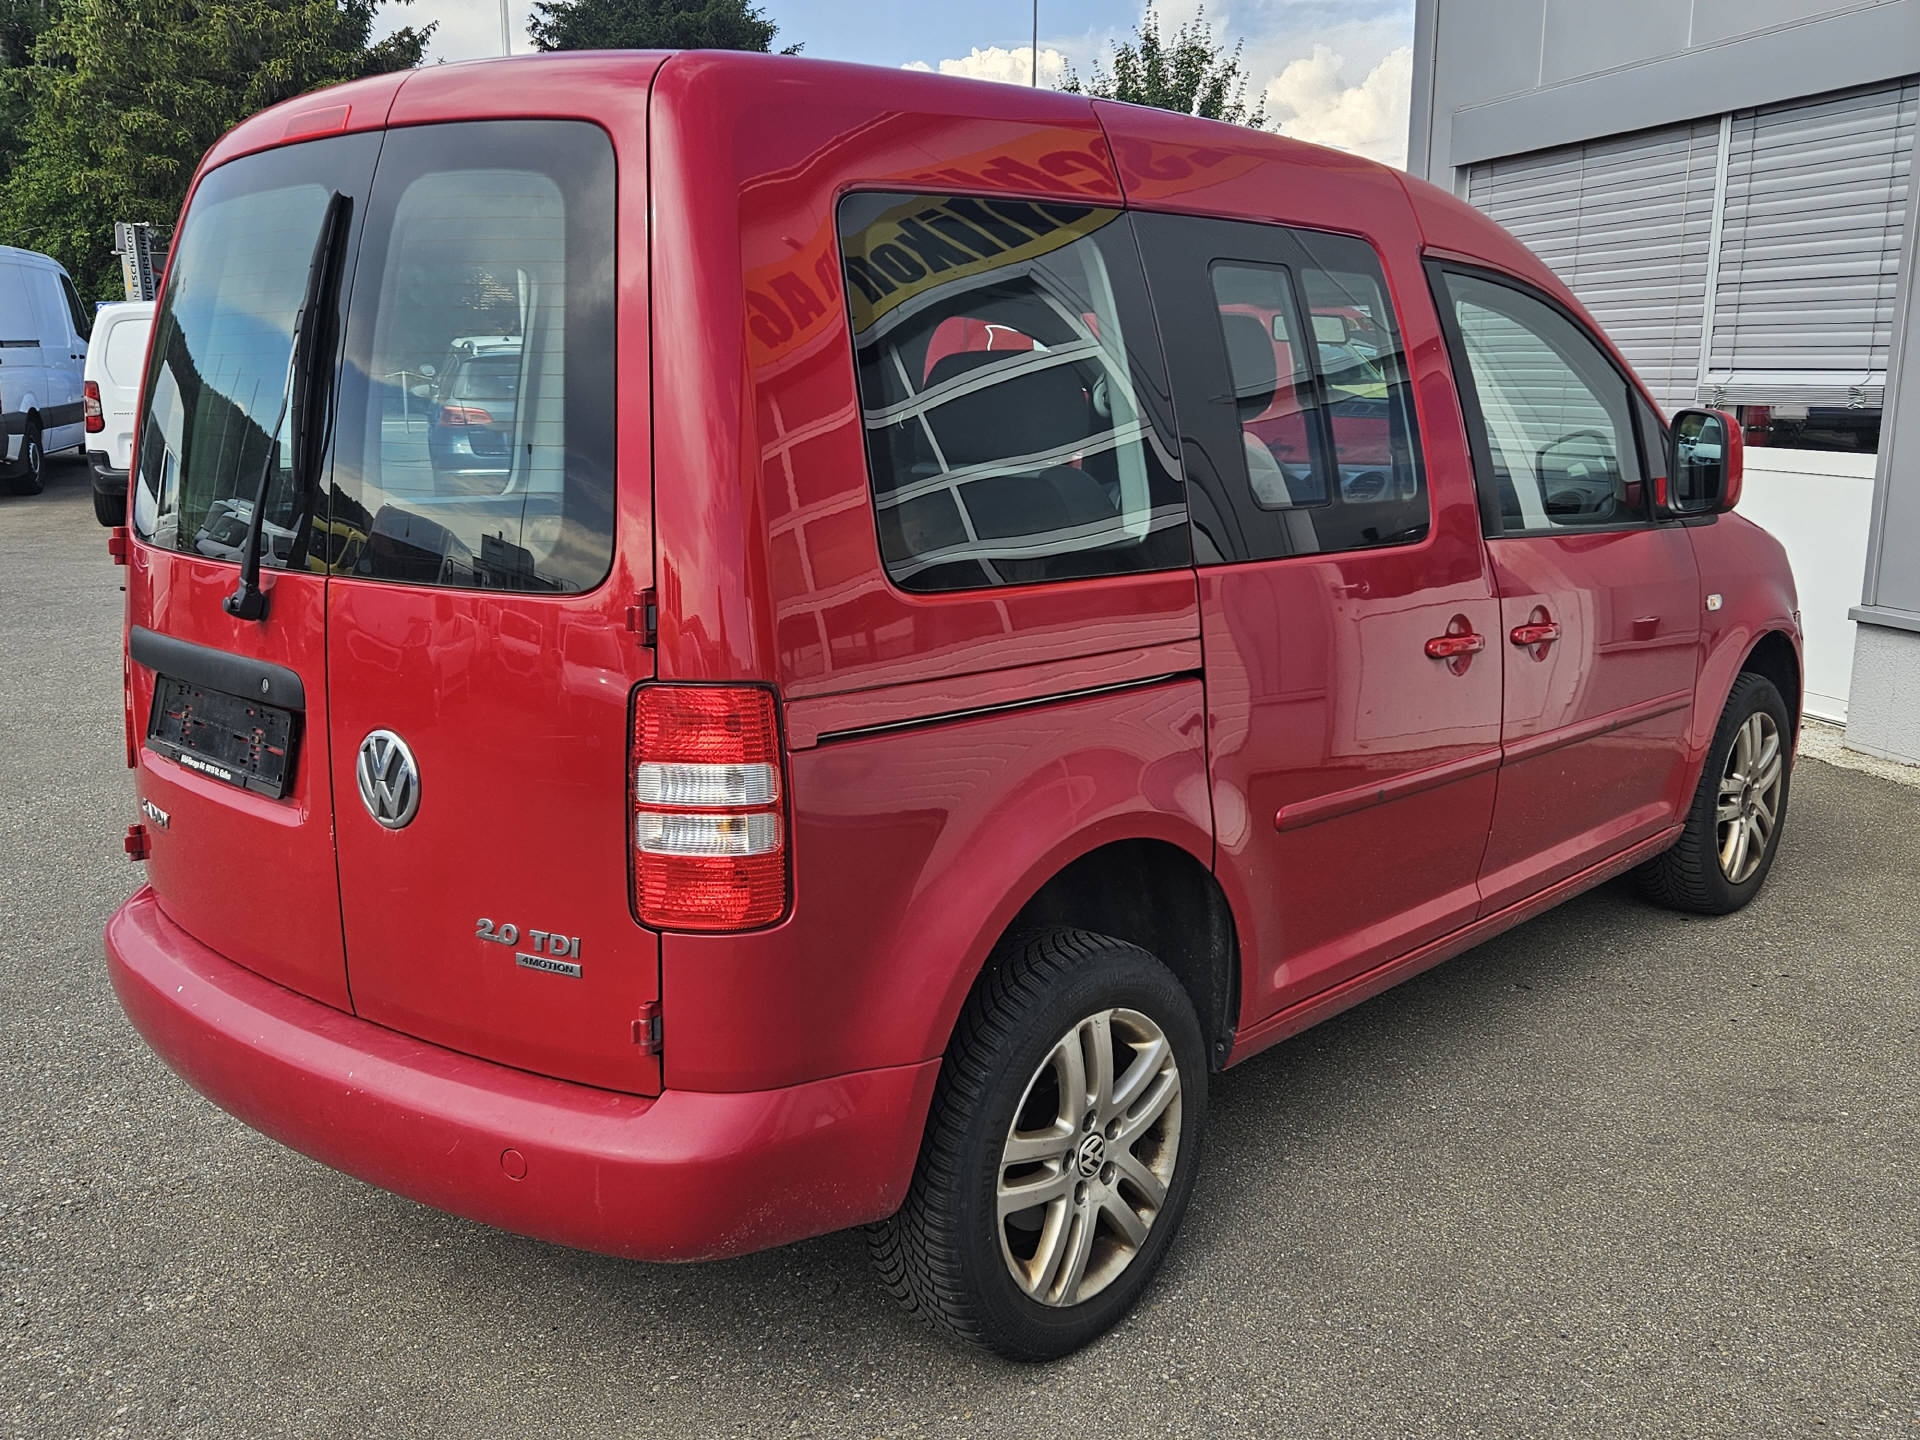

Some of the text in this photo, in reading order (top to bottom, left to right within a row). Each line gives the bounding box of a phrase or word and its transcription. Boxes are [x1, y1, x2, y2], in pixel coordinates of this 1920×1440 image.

[126, 227, 139, 288] ESCHLIKON
[475, 917, 581, 959] 2.0 TDI
[522, 957, 574, 973] 4MOTION
